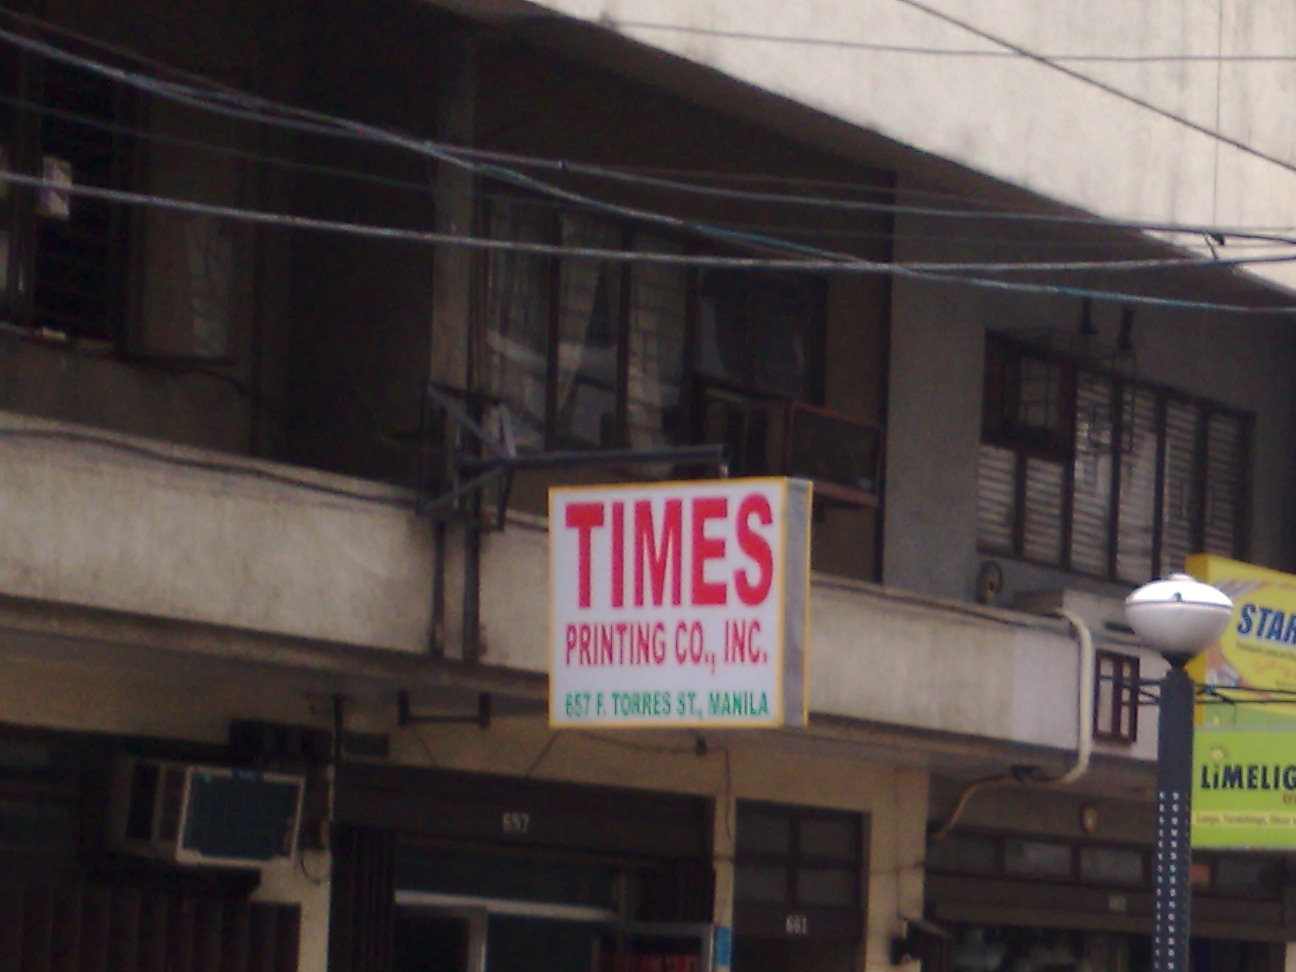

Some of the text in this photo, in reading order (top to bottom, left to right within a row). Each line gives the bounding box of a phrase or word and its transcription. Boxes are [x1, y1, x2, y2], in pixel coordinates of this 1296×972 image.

[565, 493, 774, 609] TIMES
[565, 619, 768, 675] PRINTING CO., INC.
[565, 691, 590, 717] 657
[611, 691, 671, 717] TORRES
[709, 691, 769, 716] MANILA
